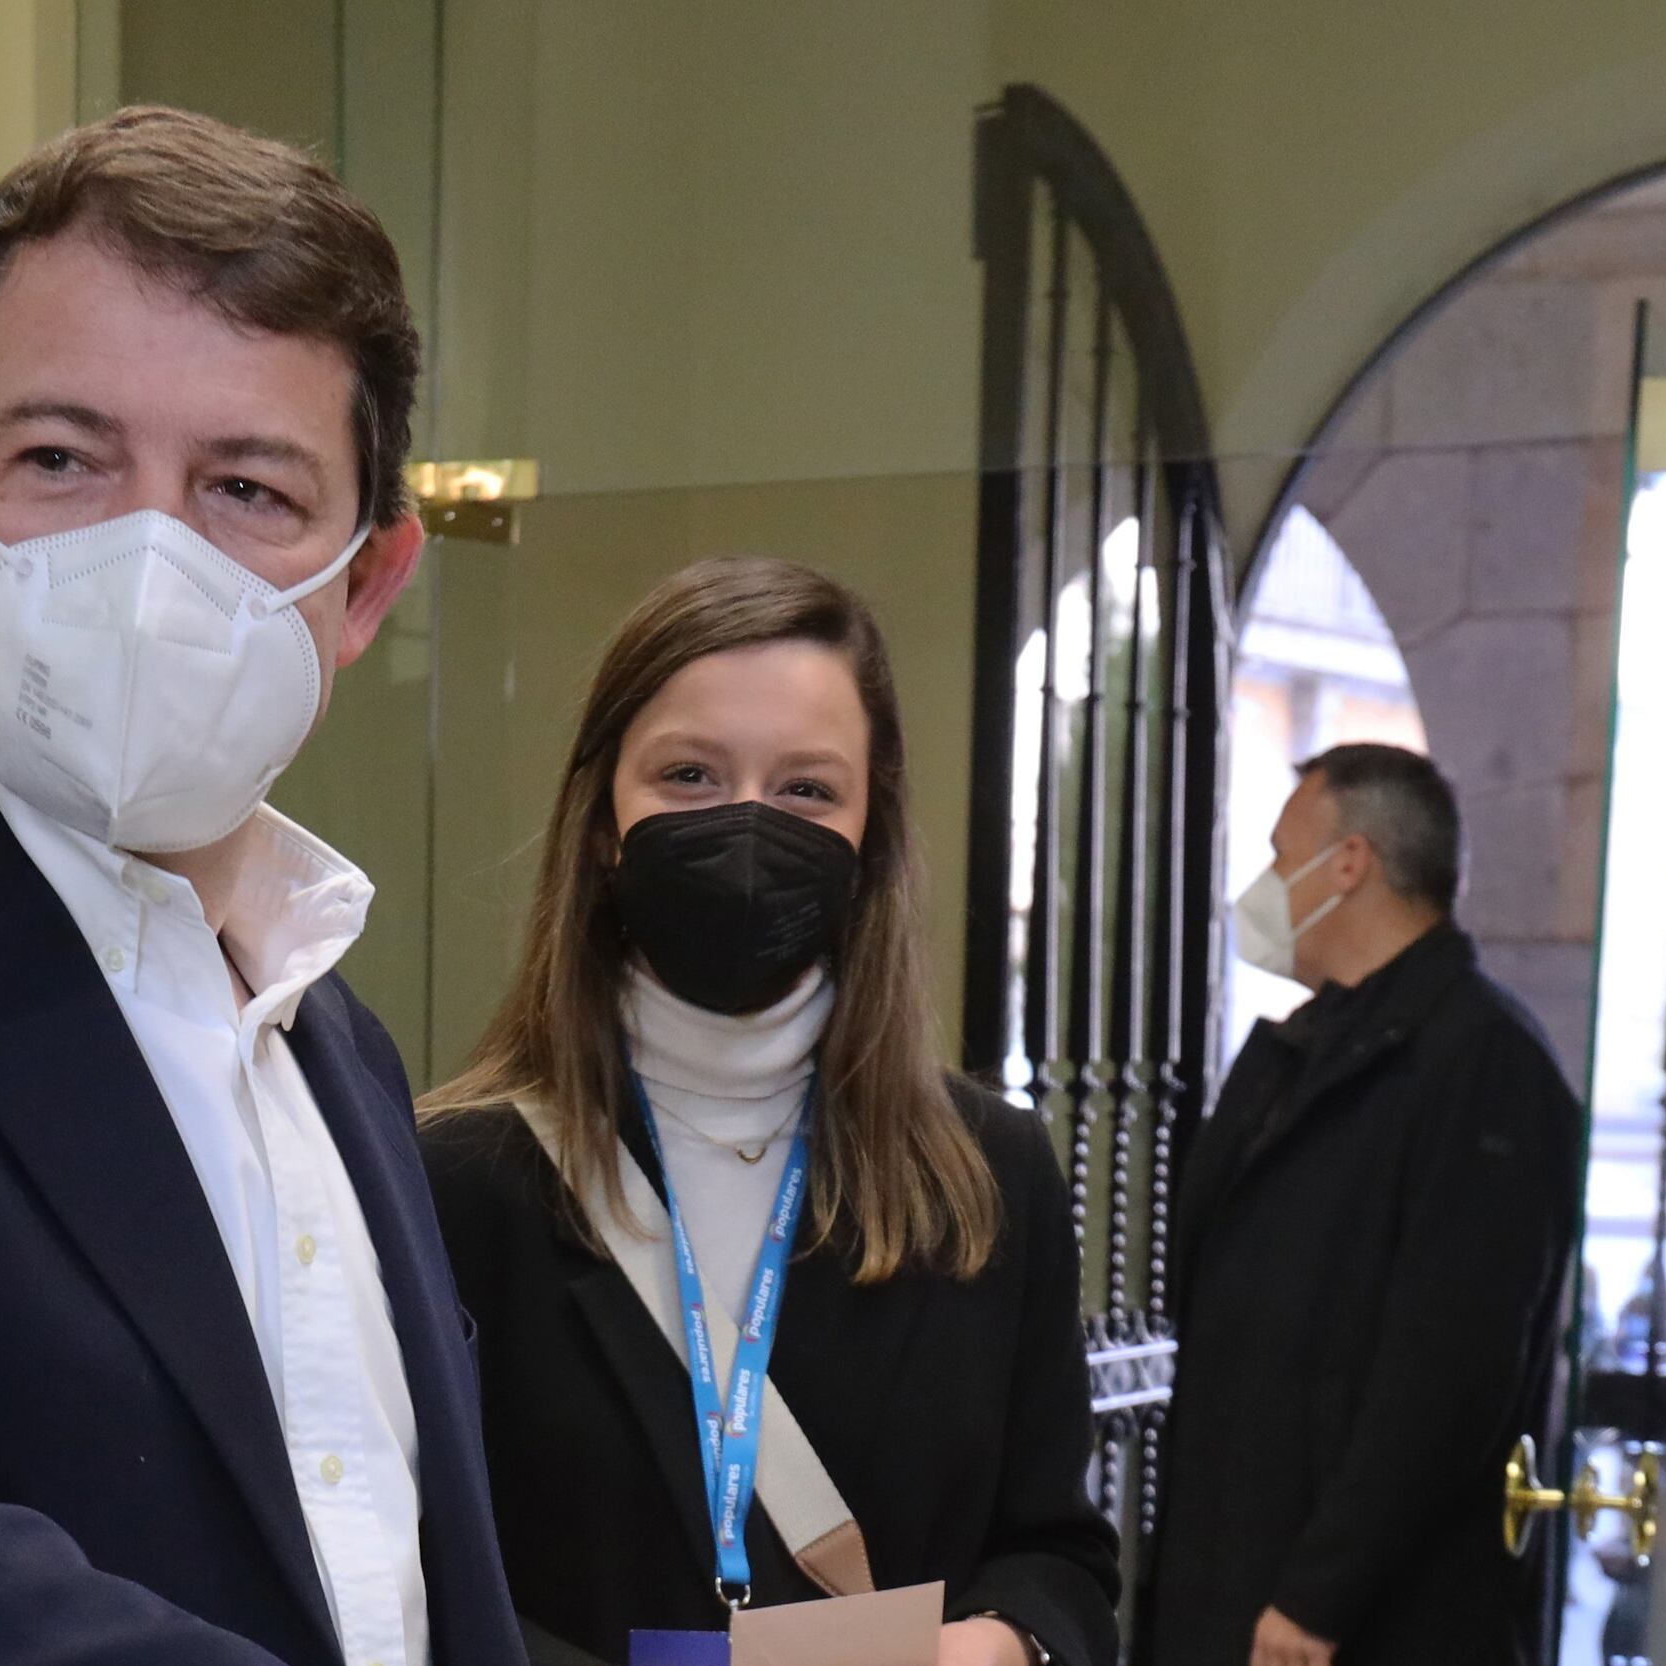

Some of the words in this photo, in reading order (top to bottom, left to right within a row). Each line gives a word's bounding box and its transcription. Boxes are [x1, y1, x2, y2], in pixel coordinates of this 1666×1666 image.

[774, 1167, 803, 1238] populares
[748, 1267, 775, 1338] populares
[691, 1310, 711, 1383] populares
[733, 1368, 751, 1433] populares
[723, 1463, 741, 1540] populares
